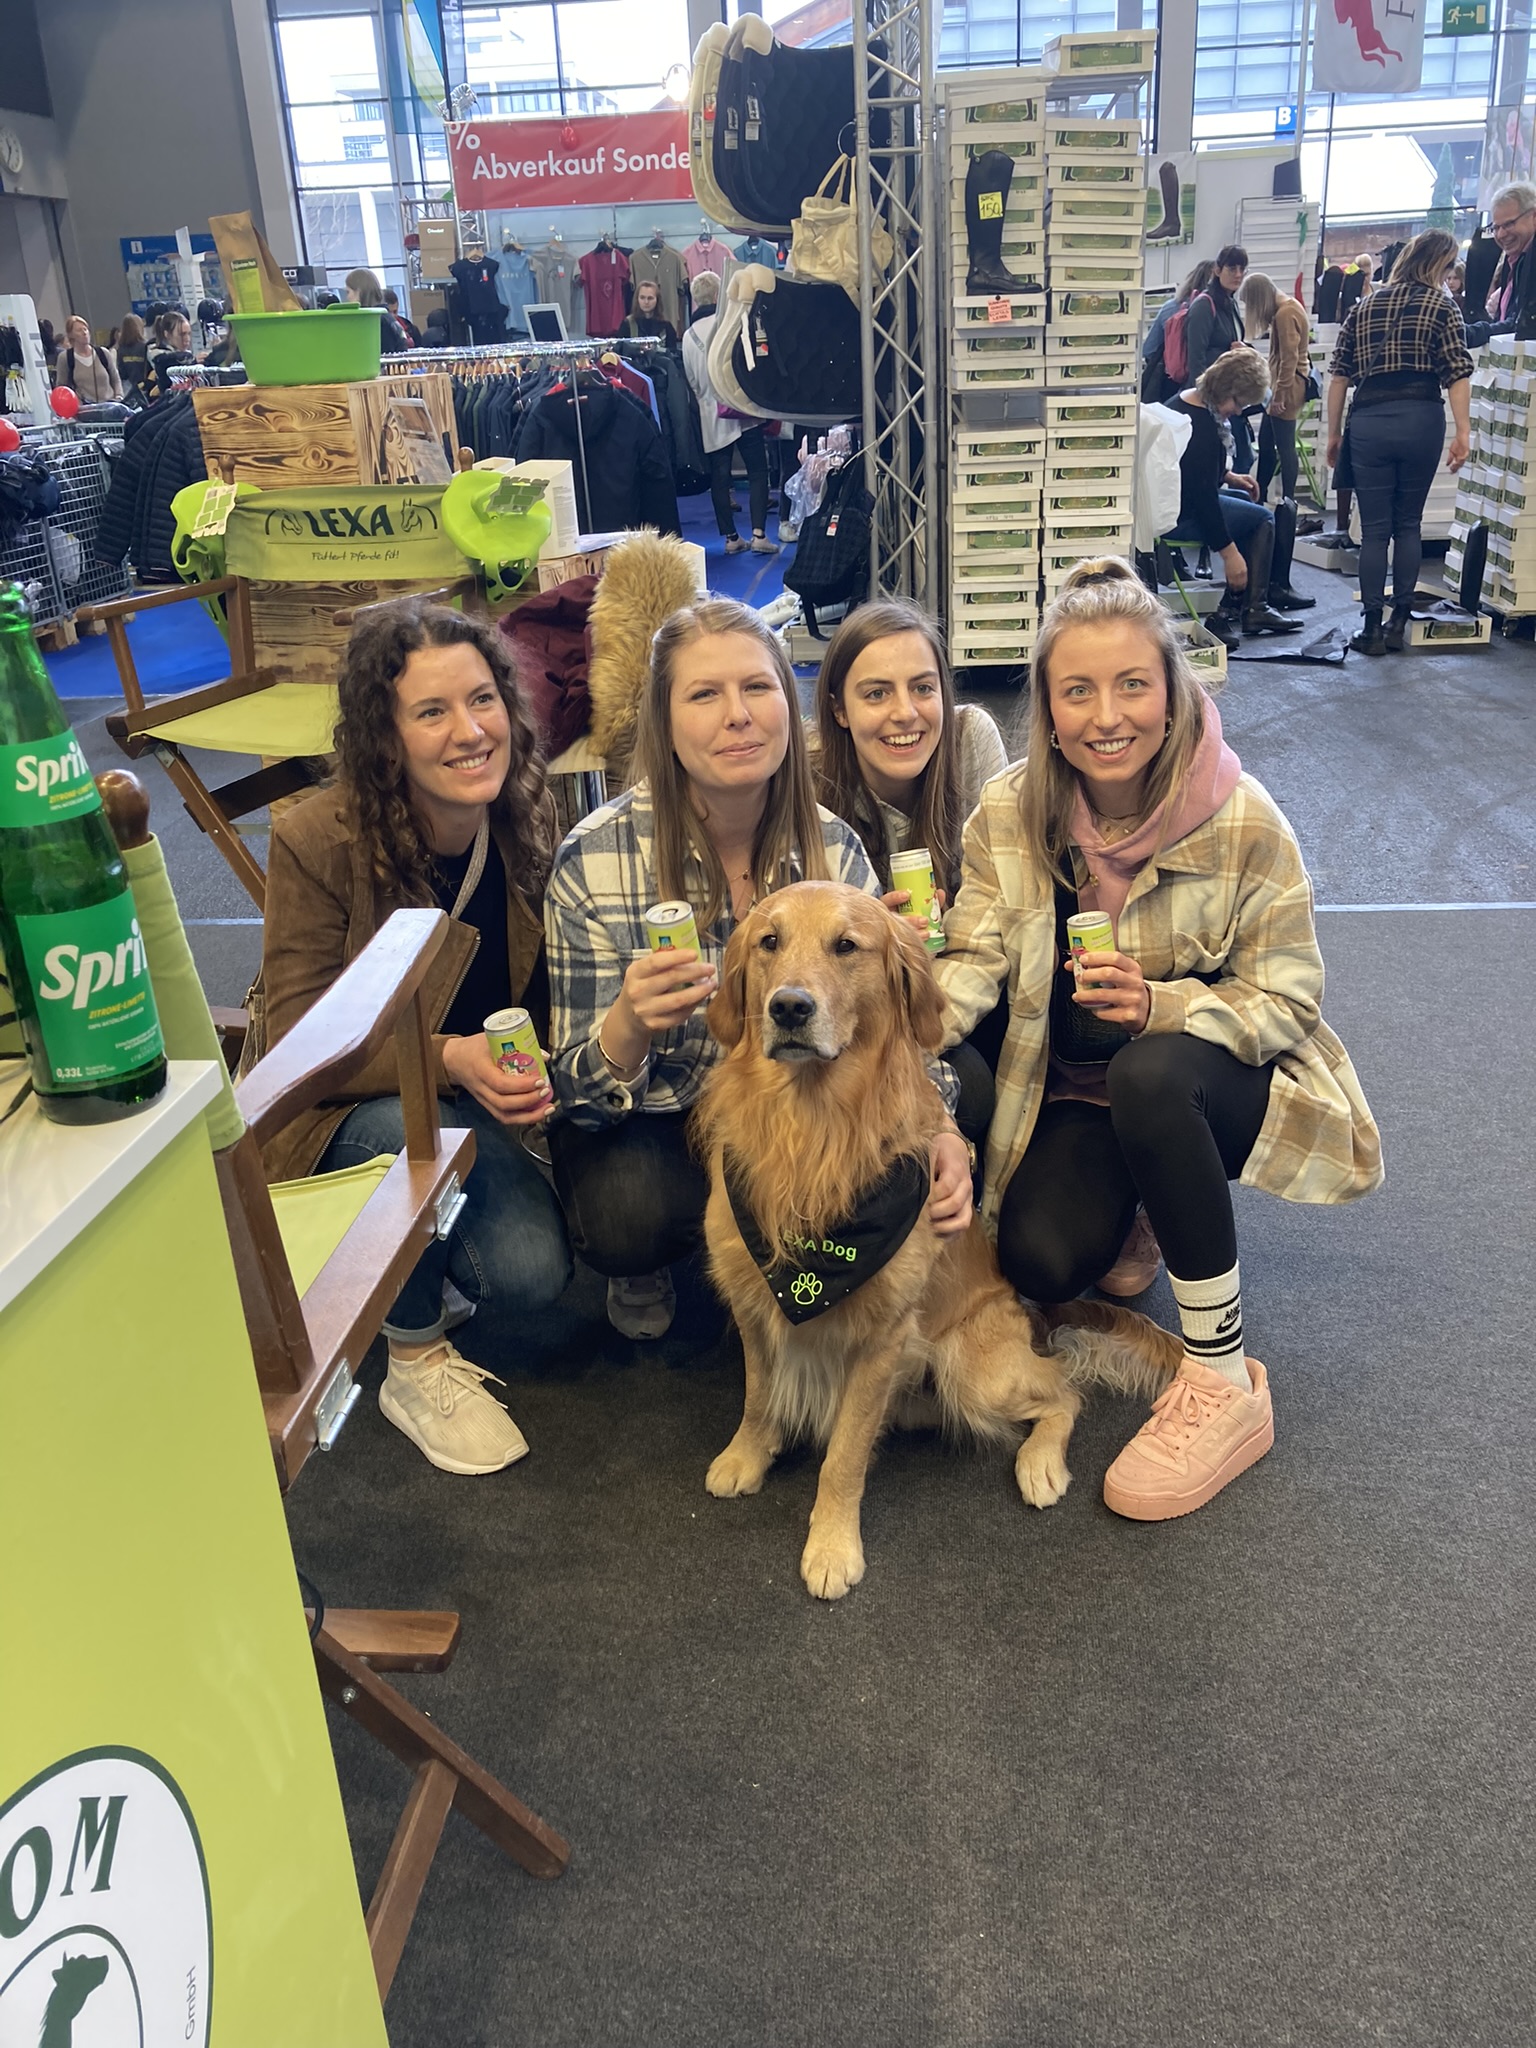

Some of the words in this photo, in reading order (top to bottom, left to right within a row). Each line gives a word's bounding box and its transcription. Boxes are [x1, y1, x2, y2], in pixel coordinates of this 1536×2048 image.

[472, 147, 607, 181] Abverkauf
[613, 142, 692, 174] Sonde
[302, 504, 395, 538] LEXA
[55, 1067, 83, 1080] 0,33L
[780, 1229, 817, 1252] EXA
[821, 1239, 857, 1262] Dog
[184, 1964, 197, 2041] GmbH
